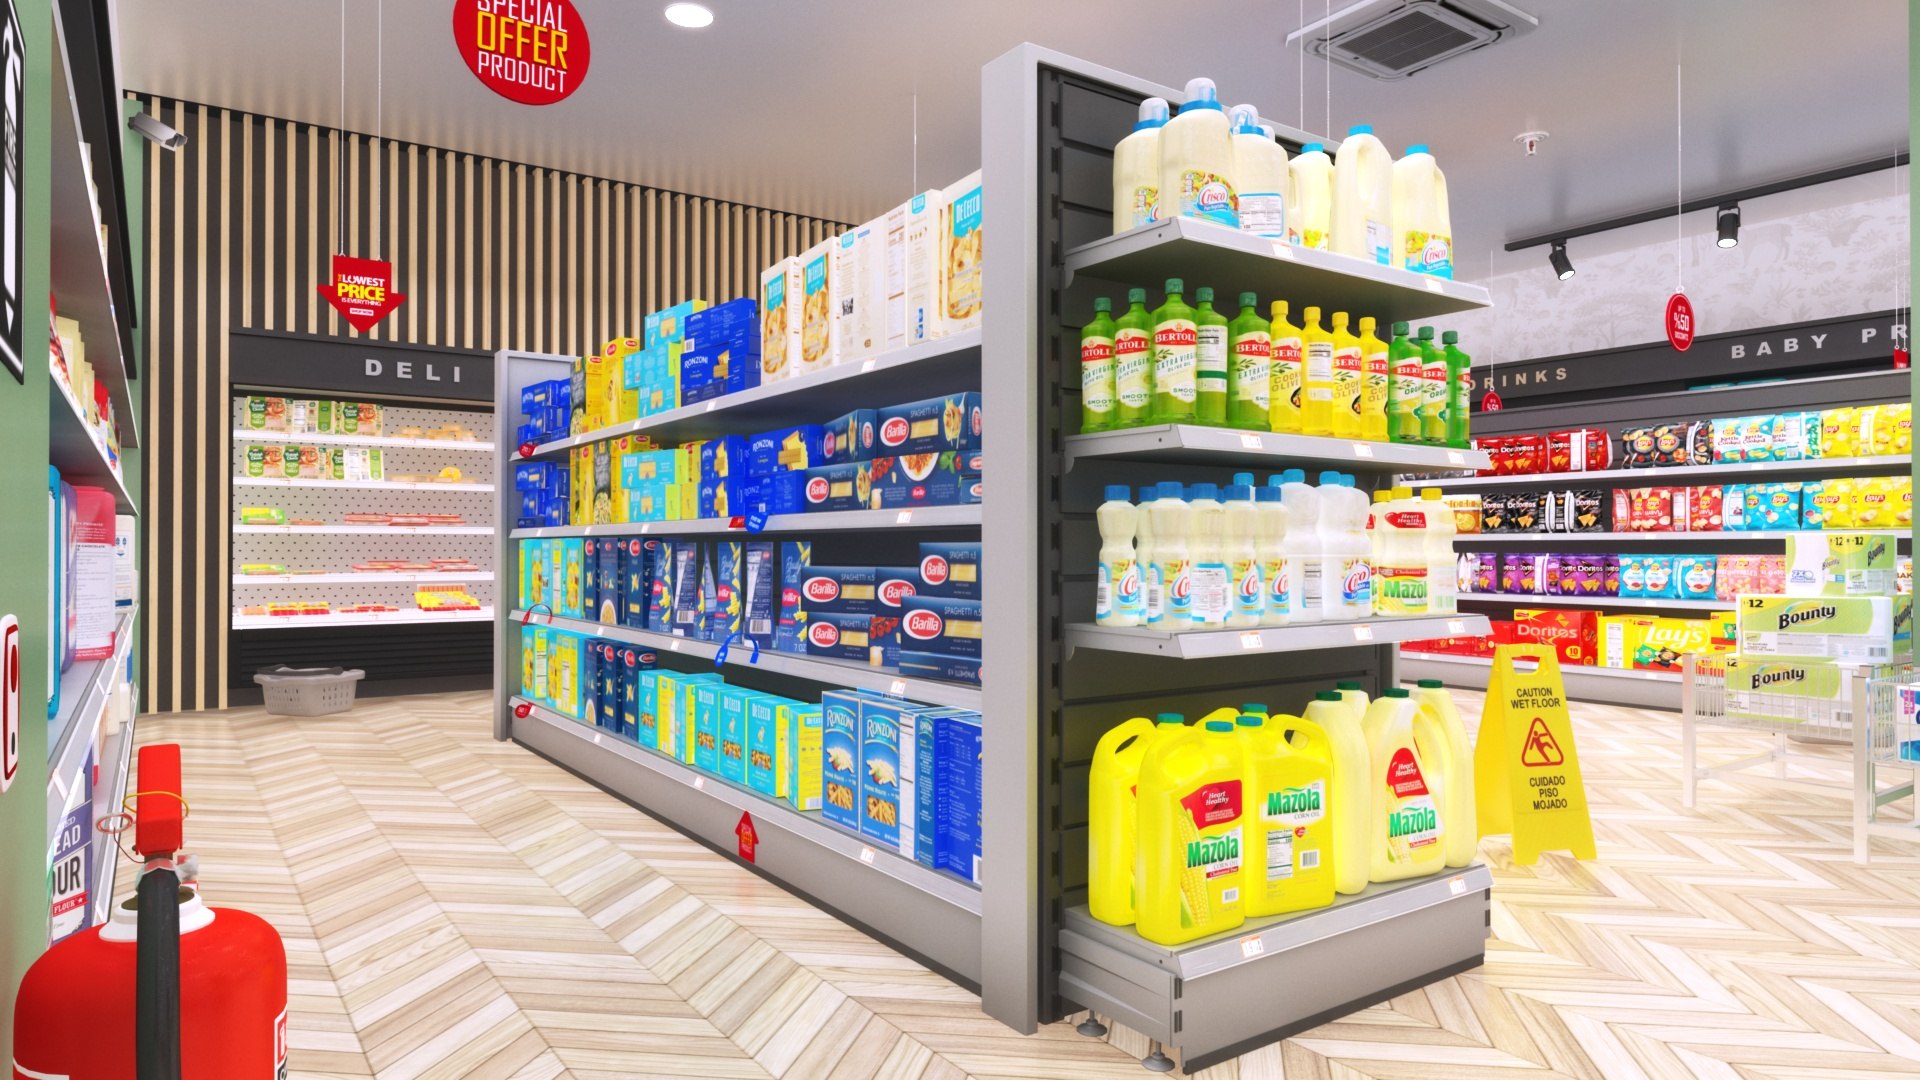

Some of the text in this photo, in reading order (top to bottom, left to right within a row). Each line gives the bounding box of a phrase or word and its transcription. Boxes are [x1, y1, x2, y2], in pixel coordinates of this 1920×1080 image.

[477, 10, 568, 70] OFFER
[478, 50, 567, 93] PRODUCT
[1201, 188, 1226, 206] Crisco
[1424, 247, 1446, 265] Crisco
[342, 274, 385, 287] LOWEST
[337, 282, 386, 302] PRICE
[346, 298, 382, 307] EVERYTHING
[1673, 312, 1690, 332] %50
[1731, 333, 1828, 359] BABY
[1082, 348, 1112, 358] RTOLL
[684, 356, 709, 369] RONZONI
[1126, 357, 1150, 371] VIRGIN
[1156, 357, 1179, 371] EXTRA
[1167, 361, 1192, 374] OLIVE OIL
[365, 358, 461, 383] DELI
[1238, 367, 1258, 380] EXTRA
[1397, 366, 1422, 375] BERT
[1423, 370, 1447, 378] BERT
[1274, 373, 1300, 385] COOK
[1336, 380, 1361, 393] COOK
[910, 406, 931, 418] SPAGHETTI
[886, 422, 908, 439] Barilla
[752, 439, 775, 453] RONZONI
[1636, 440, 1652, 448] Lay's
[1660, 439, 1677, 447] Lay's
[810, 483, 828, 497] Barilla
[1515, 501, 1536, 509] Doritos
[1576, 499, 1599, 507] Doritos
[1772, 495, 1790, 503] Lay's
[1864, 494, 1885, 503] Lay's
[1835, 536, 1844, 546] 12
[1855, 536, 1864, 546] 12
[949, 551, 970, 560] SPAGHETTI
[1867, 543, 1885, 567] Bounty
[926, 562, 946, 577] Barilla
[1822, 558, 1840, 571] Bounty
[840, 573, 867, 582] SPAGHETTI
[810, 583, 836, 596] Barilla
[886, 585, 913, 599] Barilla
[1748, 599, 1764, 608] 12
[944, 606, 973, 616] SPAGHETTI
[1778, 605, 1836, 630] Bounty
[839, 619, 862, 629] SPAGHETTI
[911, 617, 939, 632] Barilla
[814, 628, 836, 641] Barilla
[1517, 624, 1578, 639] Doritos
[1645, 625, 1704, 649] Lay's
[1569, 647, 1579, 655] 10
[1751, 668, 1805, 690] Bounty
[1516, 687, 1553, 698] CAUTION
[1510, 697, 1561, 709] WET FLOOR
[757, 705, 771, 721] CECCO
[826, 709, 854, 732] RONZONI
[866, 719, 898, 743] RONZONI
[1398, 762, 1414, 770] Heart
[1395, 768, 1417, 778] Healthy
[1529, 775, 1566, 788] CUIDADO
[1208, 791, 1226, 799] Heart
[1539, 787, 1559, 798] PISO
[1205, 796, 1230, 806] Healthy
[1267, 788, 1321, 817] Mazola
[1533, 798, 1568, 811] MOJADO
[1293, 812, 1310, 820] CORN
[1389, 806, 1436, 838] Mazola
[54, 824, 81, 857] EAD
[1187, 835, 1239, 869] Mazola
[1213, 861, 1229, 870] CORN
[1209, 869, 1231, 878] Cholesterol
[53, 900, 76, 914] FLOUR
